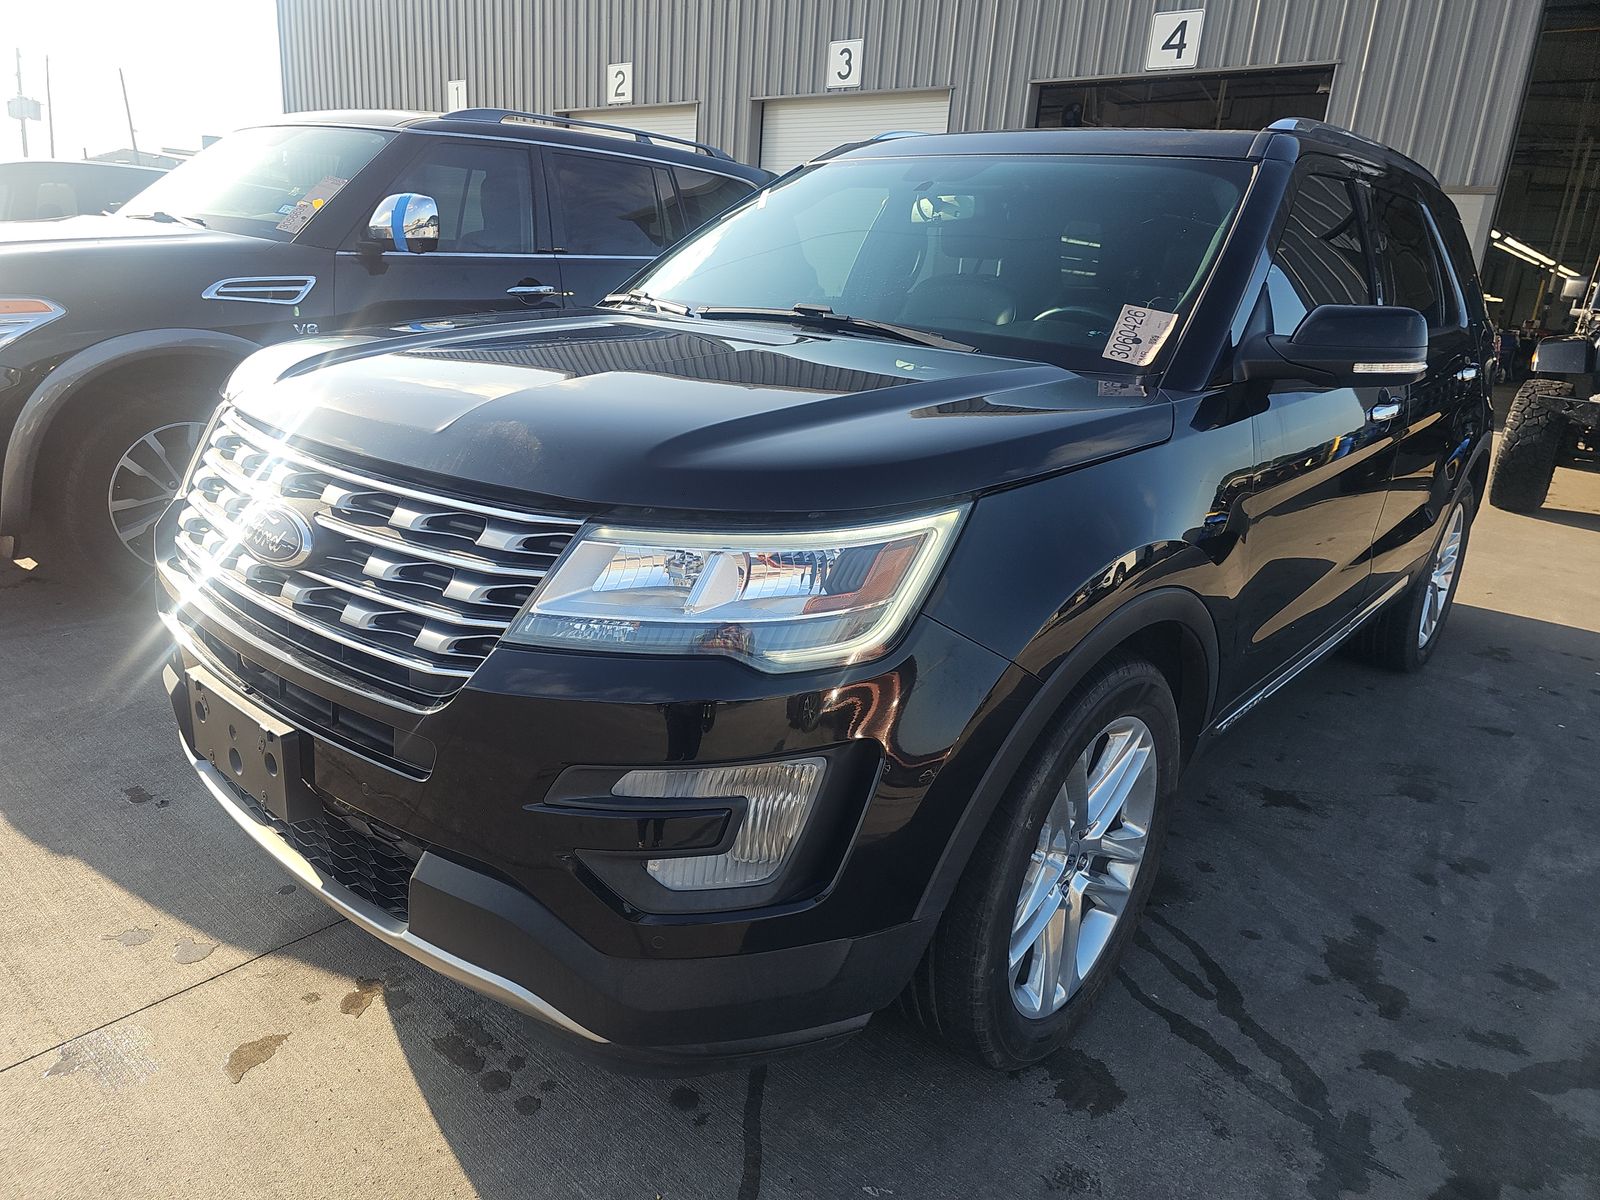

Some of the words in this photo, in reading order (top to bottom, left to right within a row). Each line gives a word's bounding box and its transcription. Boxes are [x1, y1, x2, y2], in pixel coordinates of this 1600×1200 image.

[1161, 19, 1188, 60] 4
[837, 47, 853, 81] 3
[614, 70, 626, 97] 2
[292, 323, 319, 335] V8
[1110, 309, 1146, 359] 3060426
